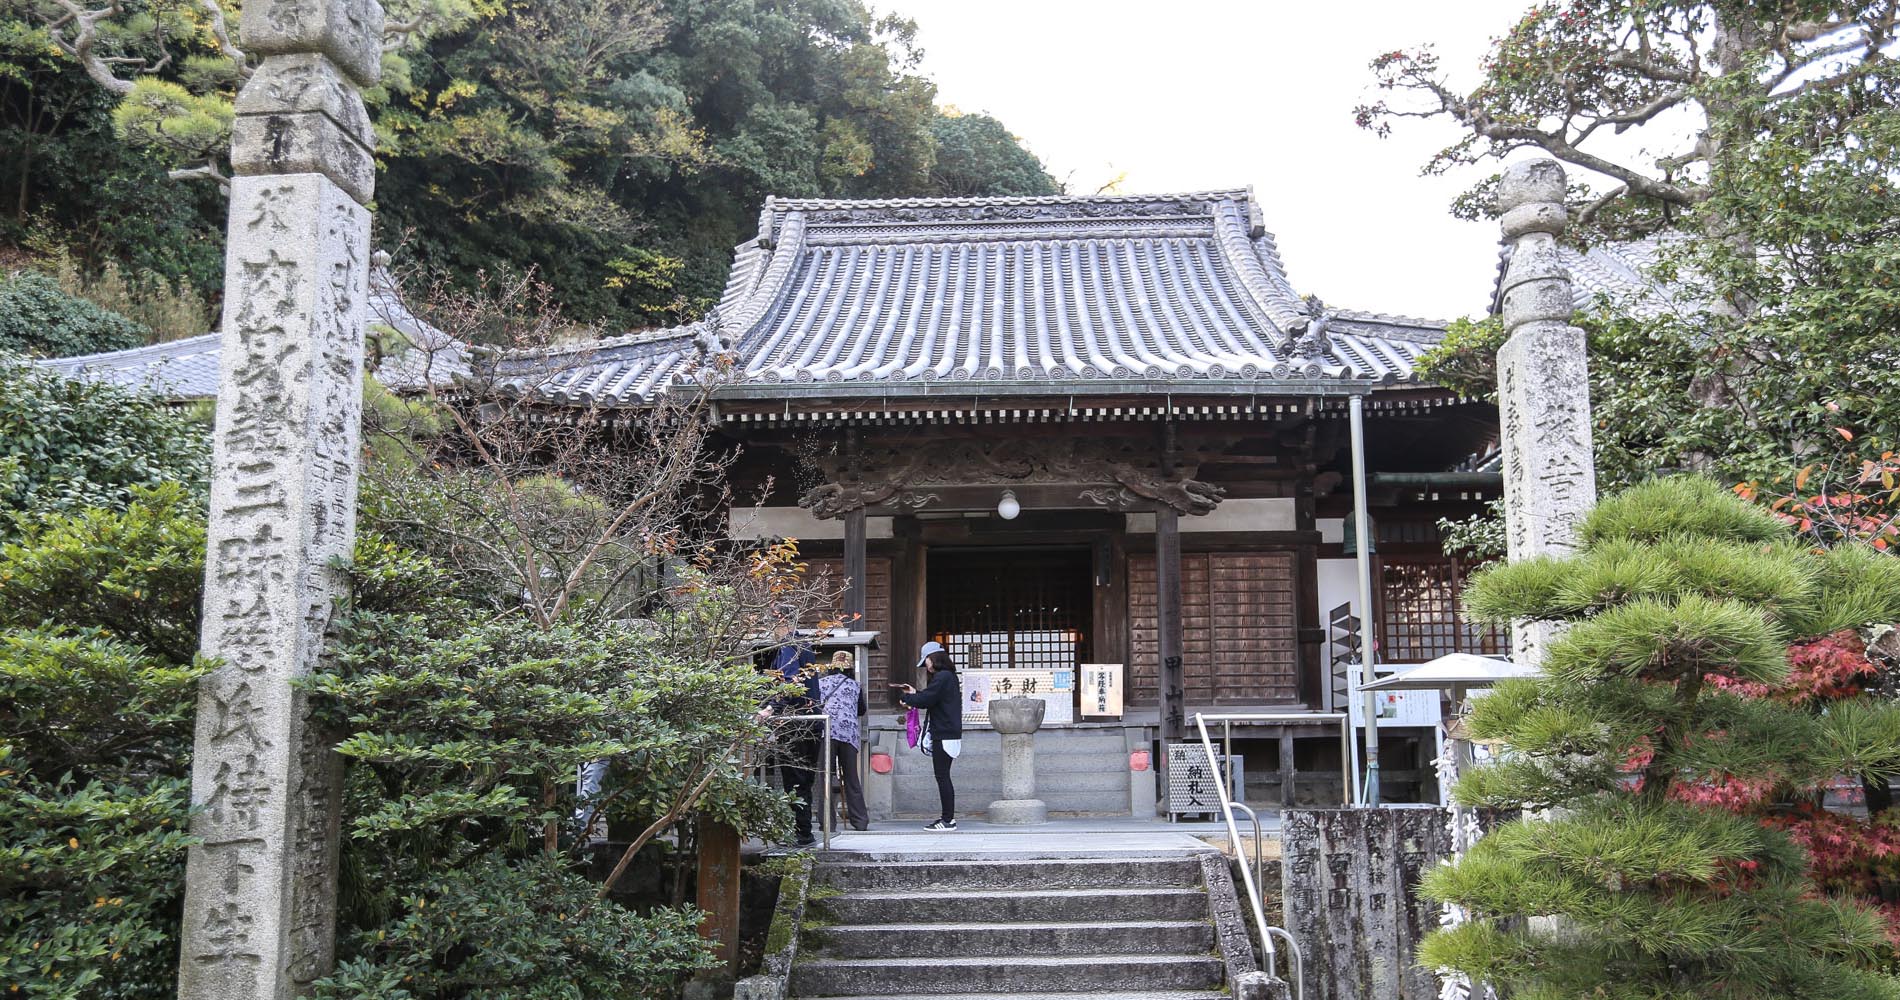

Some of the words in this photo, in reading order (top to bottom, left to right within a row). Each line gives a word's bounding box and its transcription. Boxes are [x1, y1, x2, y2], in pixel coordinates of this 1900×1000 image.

[996, 677, 1037, 694] 浄財
[1164, 655, 1185, 730] 甲山寺
[1187, 765, 1204, 807] 納札入
